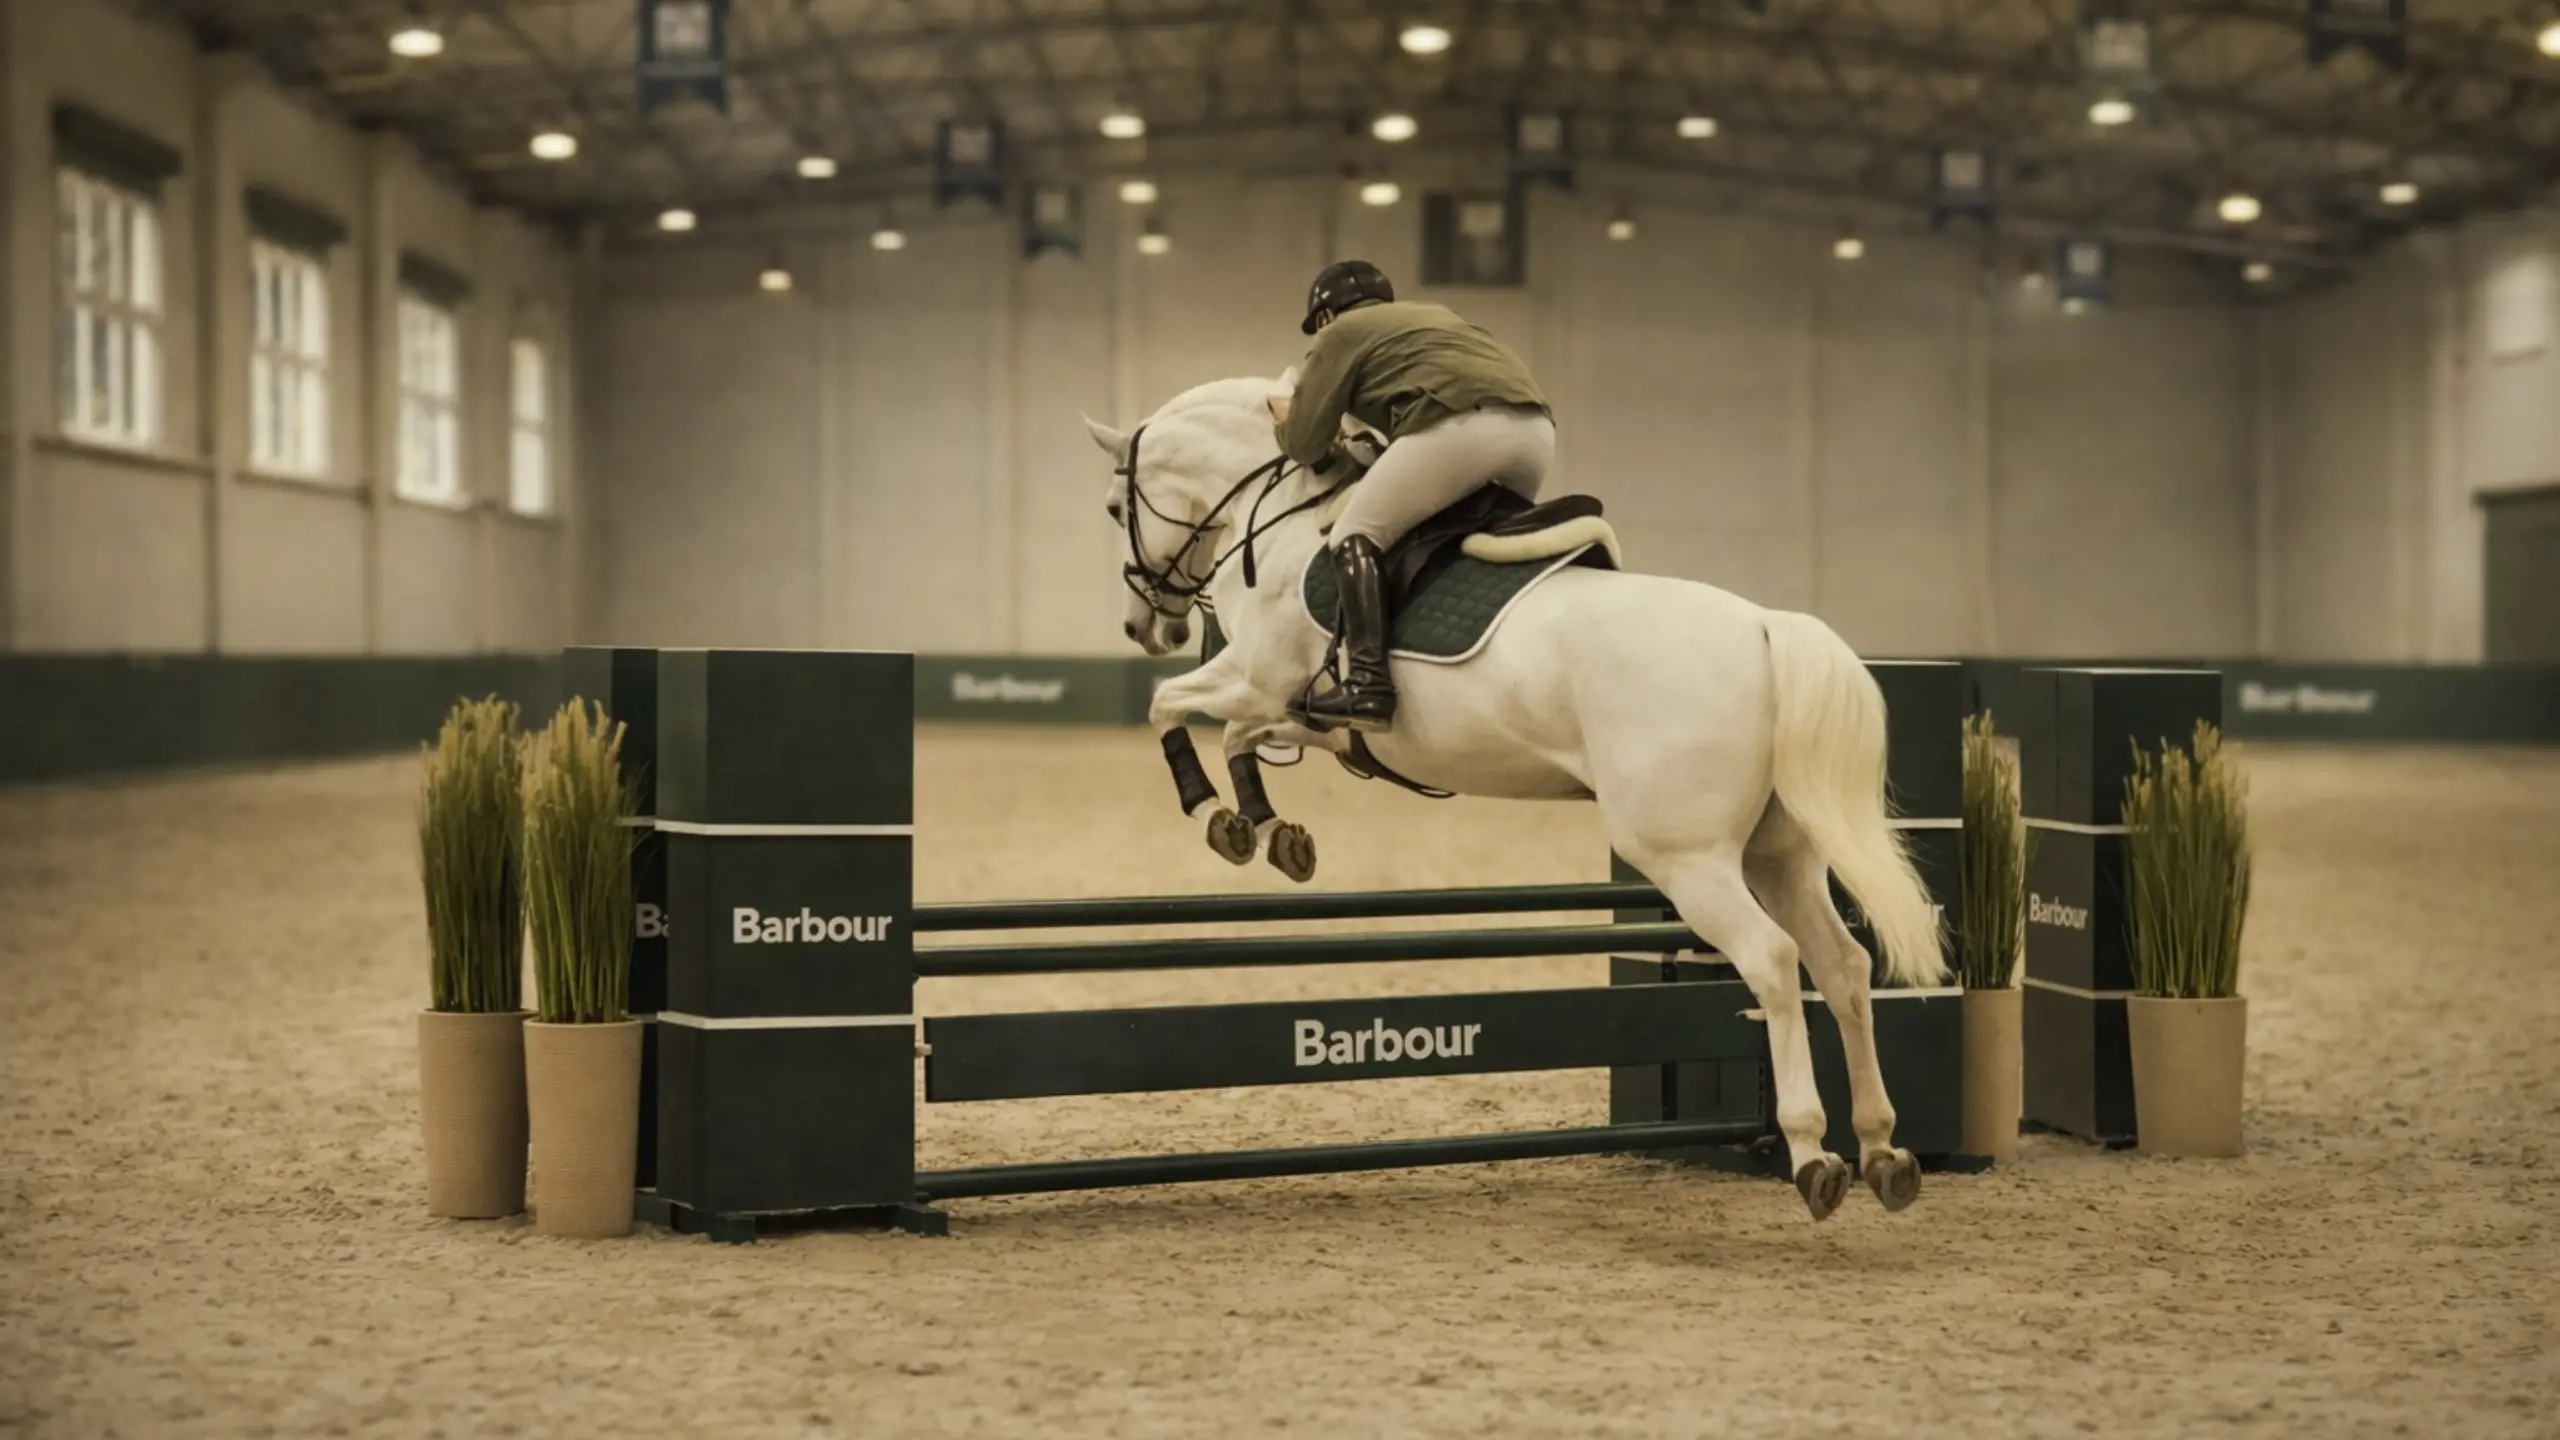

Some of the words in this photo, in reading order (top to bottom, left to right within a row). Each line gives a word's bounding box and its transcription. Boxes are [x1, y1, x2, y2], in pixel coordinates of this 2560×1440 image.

[732, 907, 892, 944] Barbour
[2029, 891, 2089, 930] Barbour
[1294, 1018, 1482, 1067] Barbour
